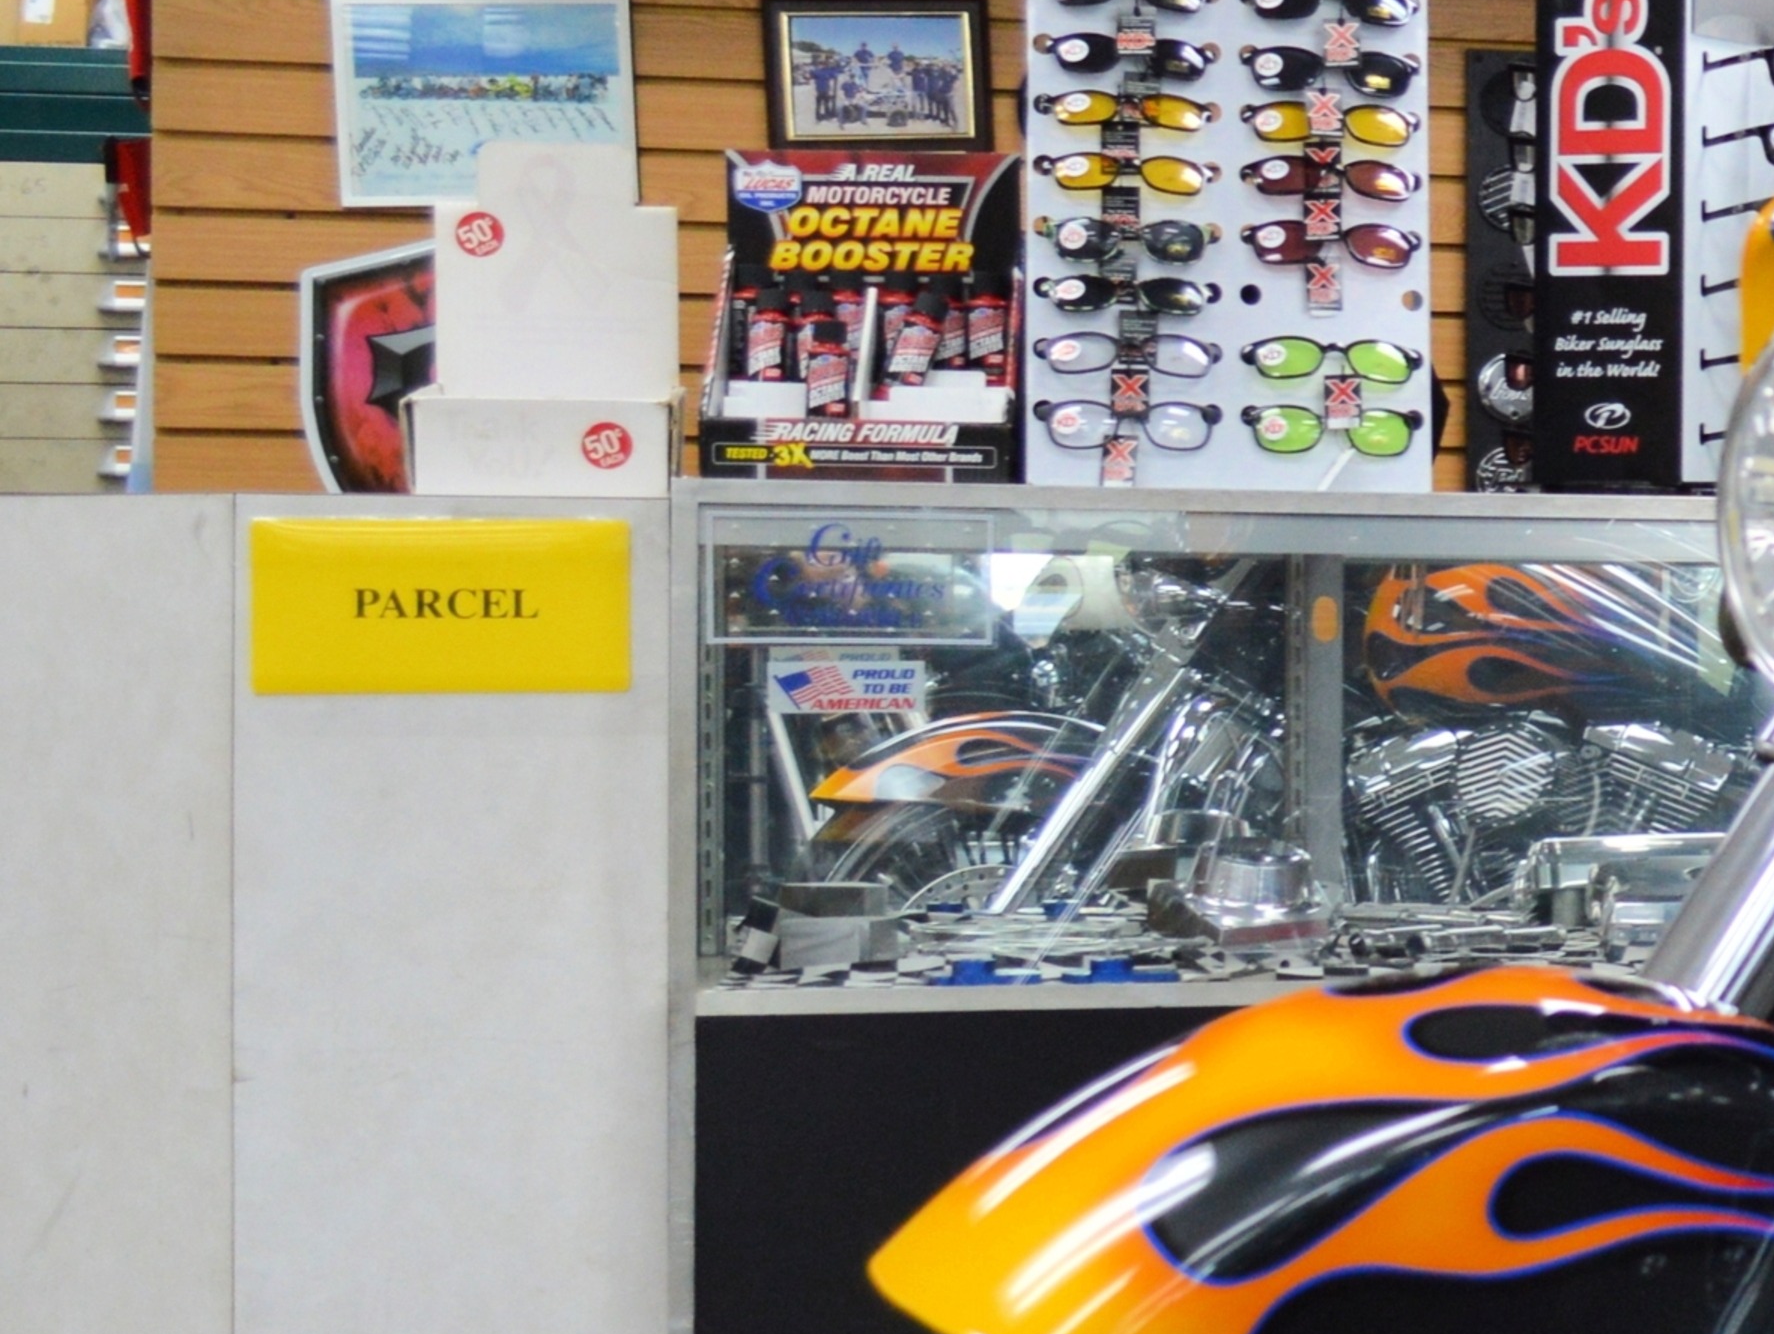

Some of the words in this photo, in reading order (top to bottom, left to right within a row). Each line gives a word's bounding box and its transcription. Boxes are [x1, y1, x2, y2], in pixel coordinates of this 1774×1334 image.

[862, 164, 916, 181] REAL
[743, 177, 794, 190] LUCAS
[806, 186, 951, 206] MOTORCYCLE
[786, 207, 964, 239] OCTANE
[768, 240, 974, 273] BOOSTER
[1570, 310, 1591, 325] #1
[1592, 306, 1648, 333] Selling
[1554, 334, 1596, 352] Biker
[1596, 334, 1664, 359] Sunglass
[1556, 361, 1575, 378] in
[1576, 360, 1604, 378] the
[1606, 360, 1661, 378] World!
[773, 421, 855, 442] RACING
[857, 423, 959, 445] FORMULA
[725, 447, 768, 460] TESTED
[1573, 435, 1639, 454] PCSUN
[353, 588, 540, 621] PARCEL
[852, 668, 916, 681] PROUD
[863, 682, 885, 695] TO
[888, 682, 912, 695] BE
[809, 697, 917, 712] AMERICAN
